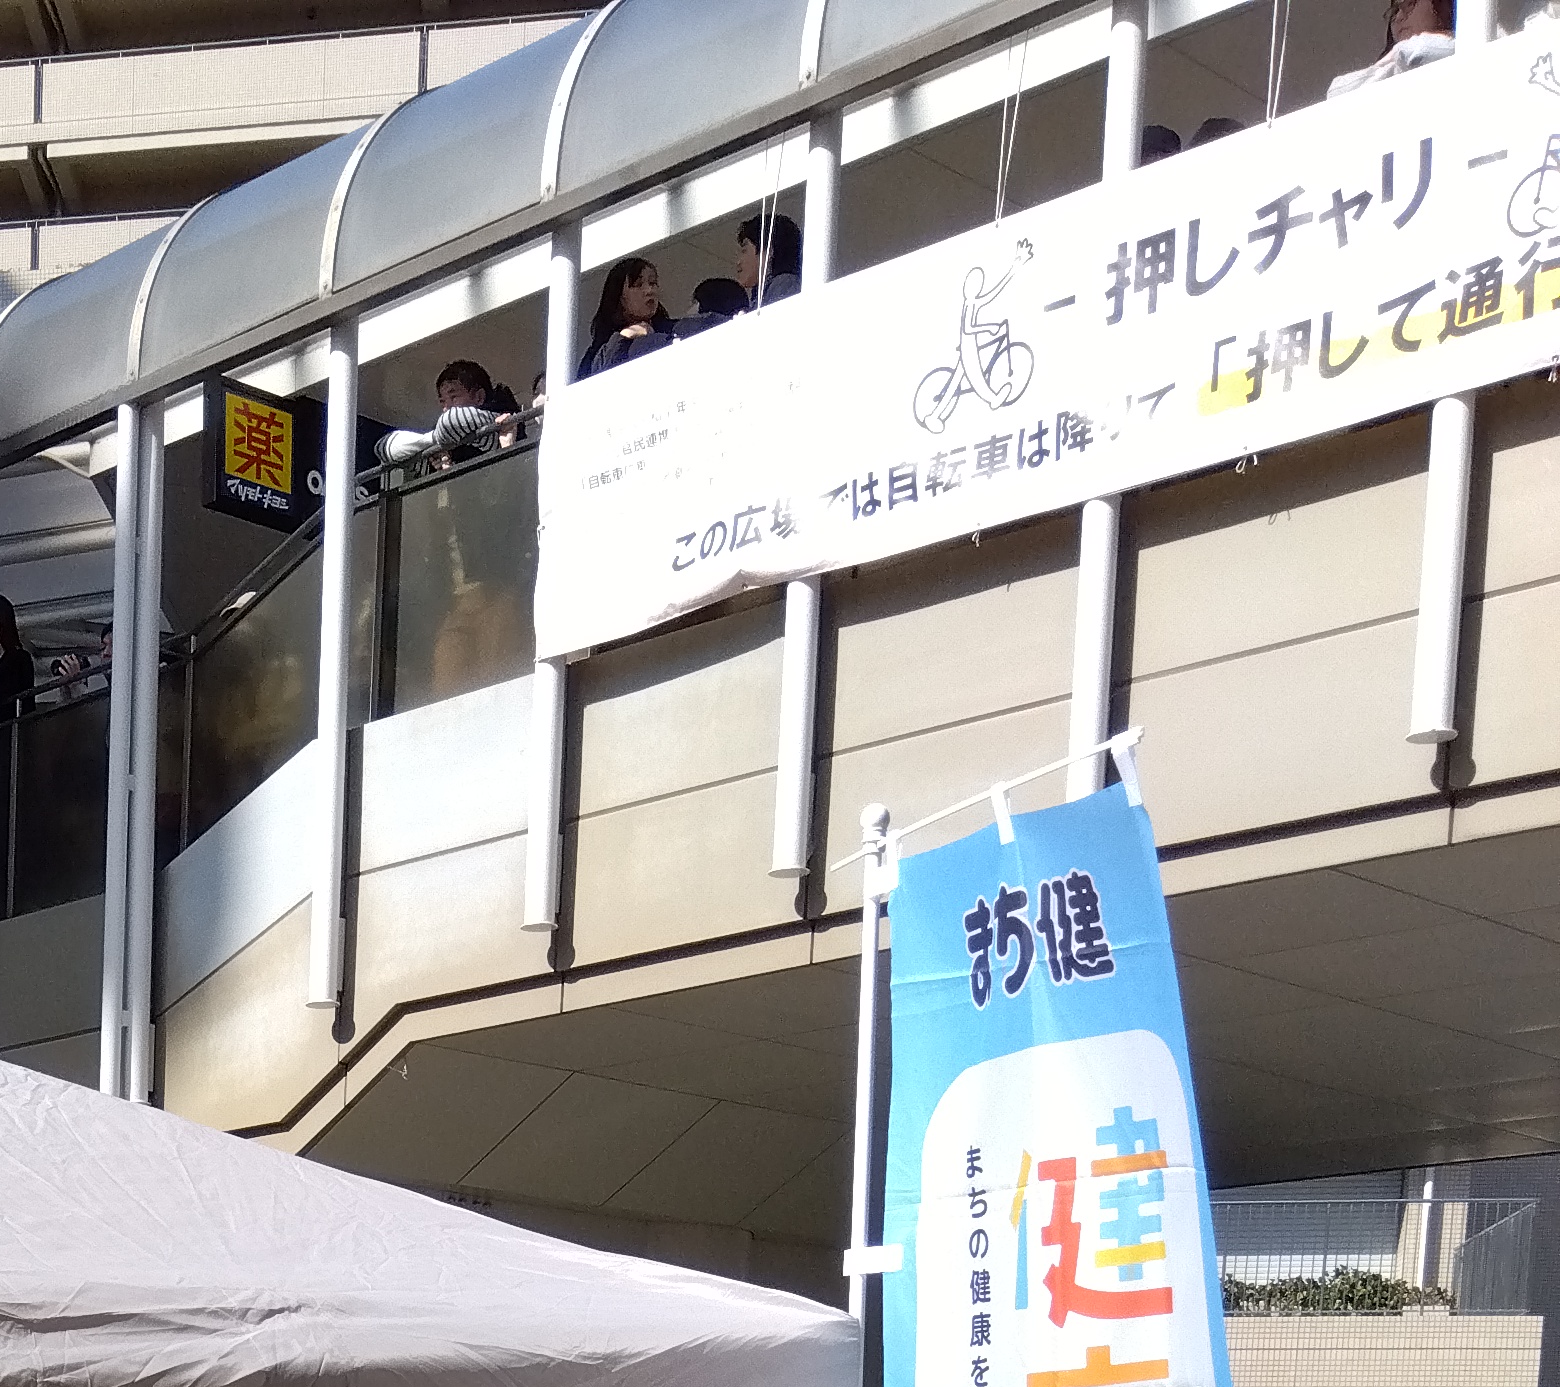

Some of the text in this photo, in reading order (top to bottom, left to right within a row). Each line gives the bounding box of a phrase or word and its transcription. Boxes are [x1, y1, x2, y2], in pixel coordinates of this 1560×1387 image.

[234, 402, 285, 488] 薬
[226, 478, 290, 510] マツモトキヨシ
[963, 868, 1117, 1010] まち健
